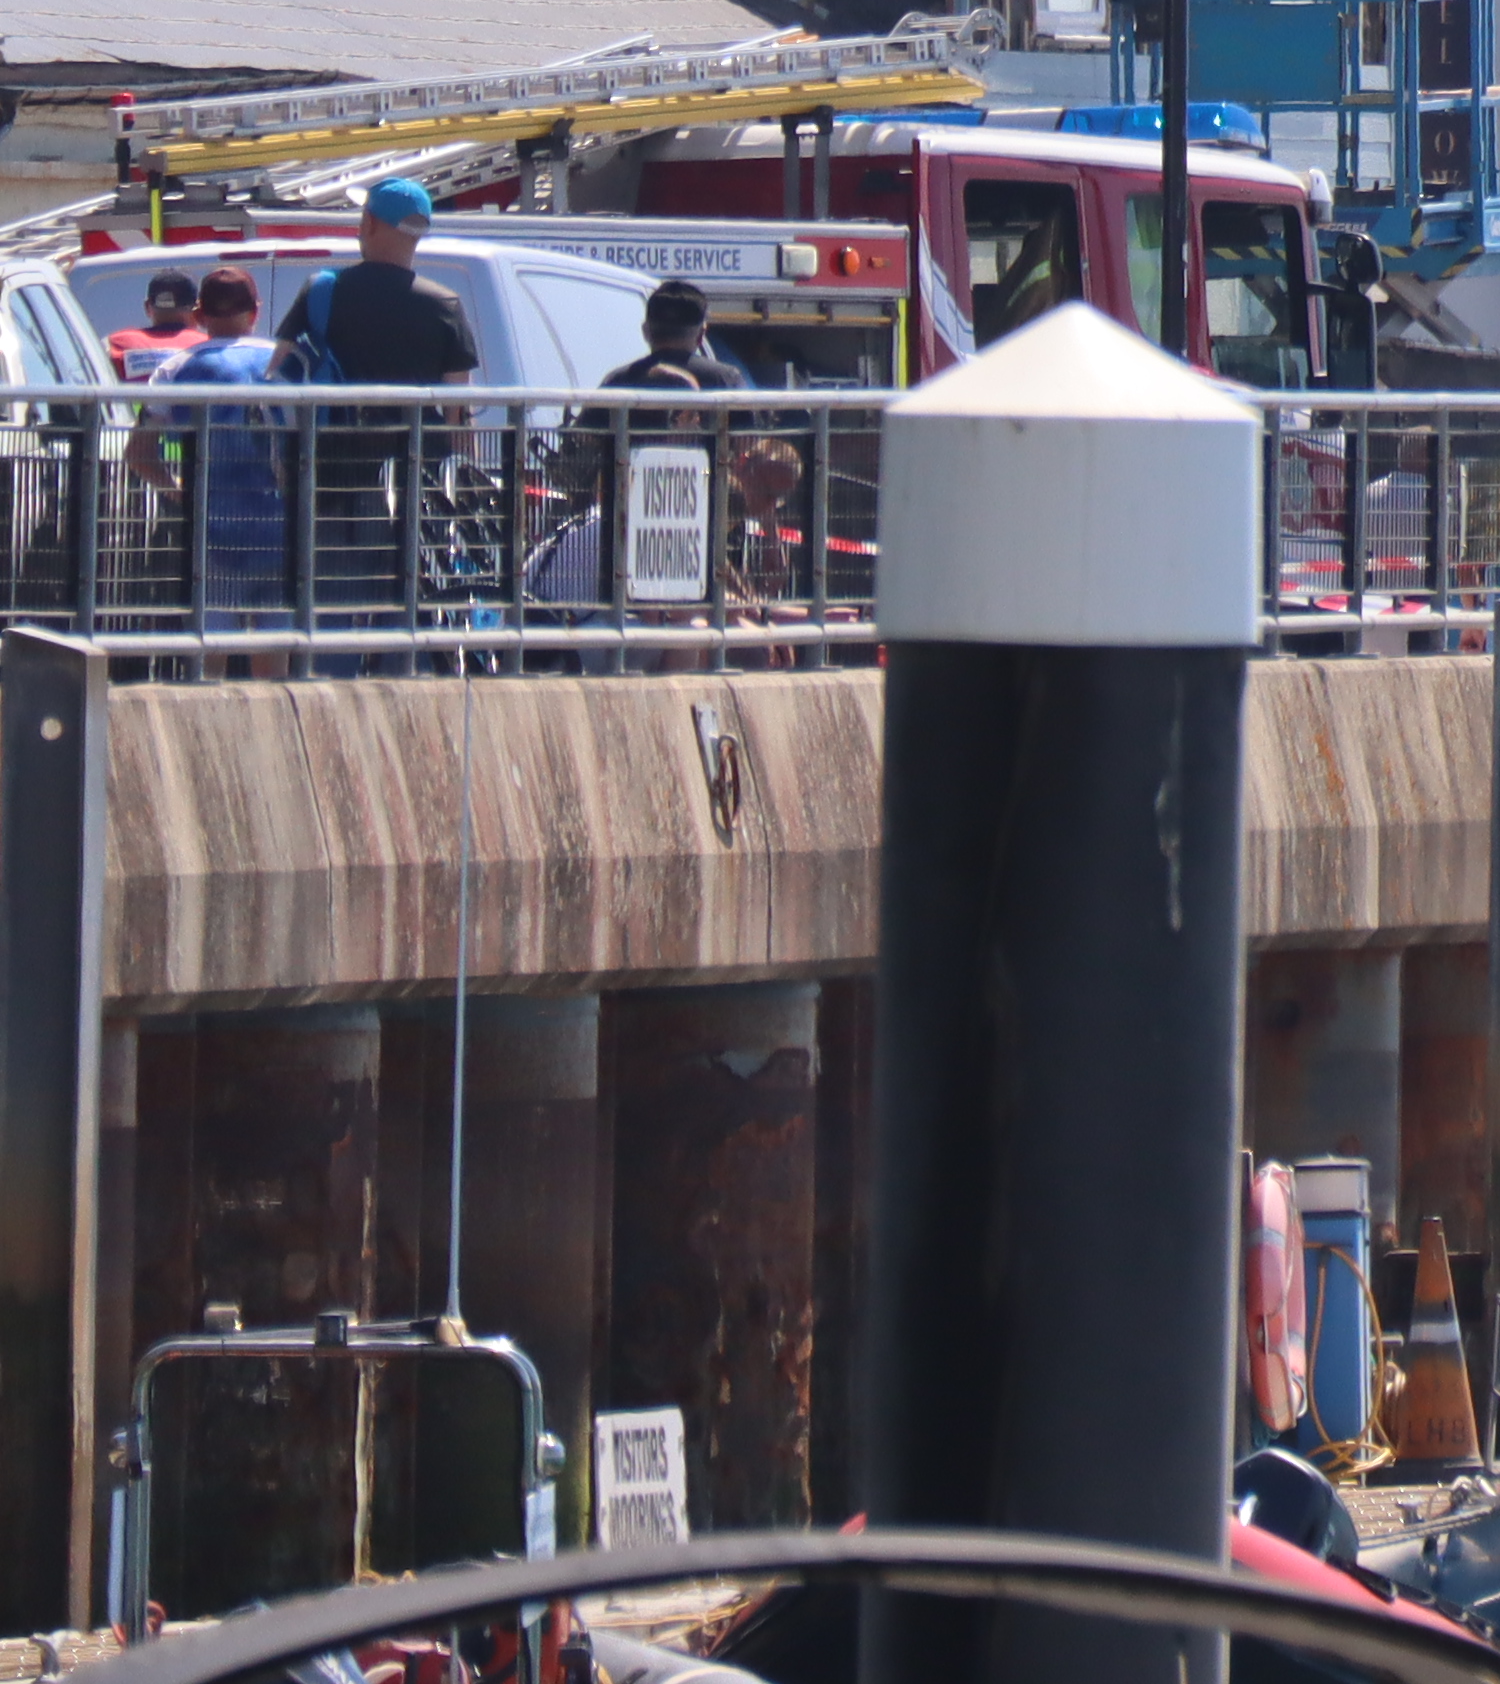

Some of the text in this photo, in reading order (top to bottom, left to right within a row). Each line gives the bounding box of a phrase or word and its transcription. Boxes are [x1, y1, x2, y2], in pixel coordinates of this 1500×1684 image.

[606, 246, 668, 270] RESCUE
[674, 248, 741, 271] SERVICE
[642, 466, 697, 518] VISITORS
[635, 527, 700, 581] MOORINGS
[613, 1425, 669, 1483] VISITORS
[608, 1489, 677, 1547] MOORINGS
